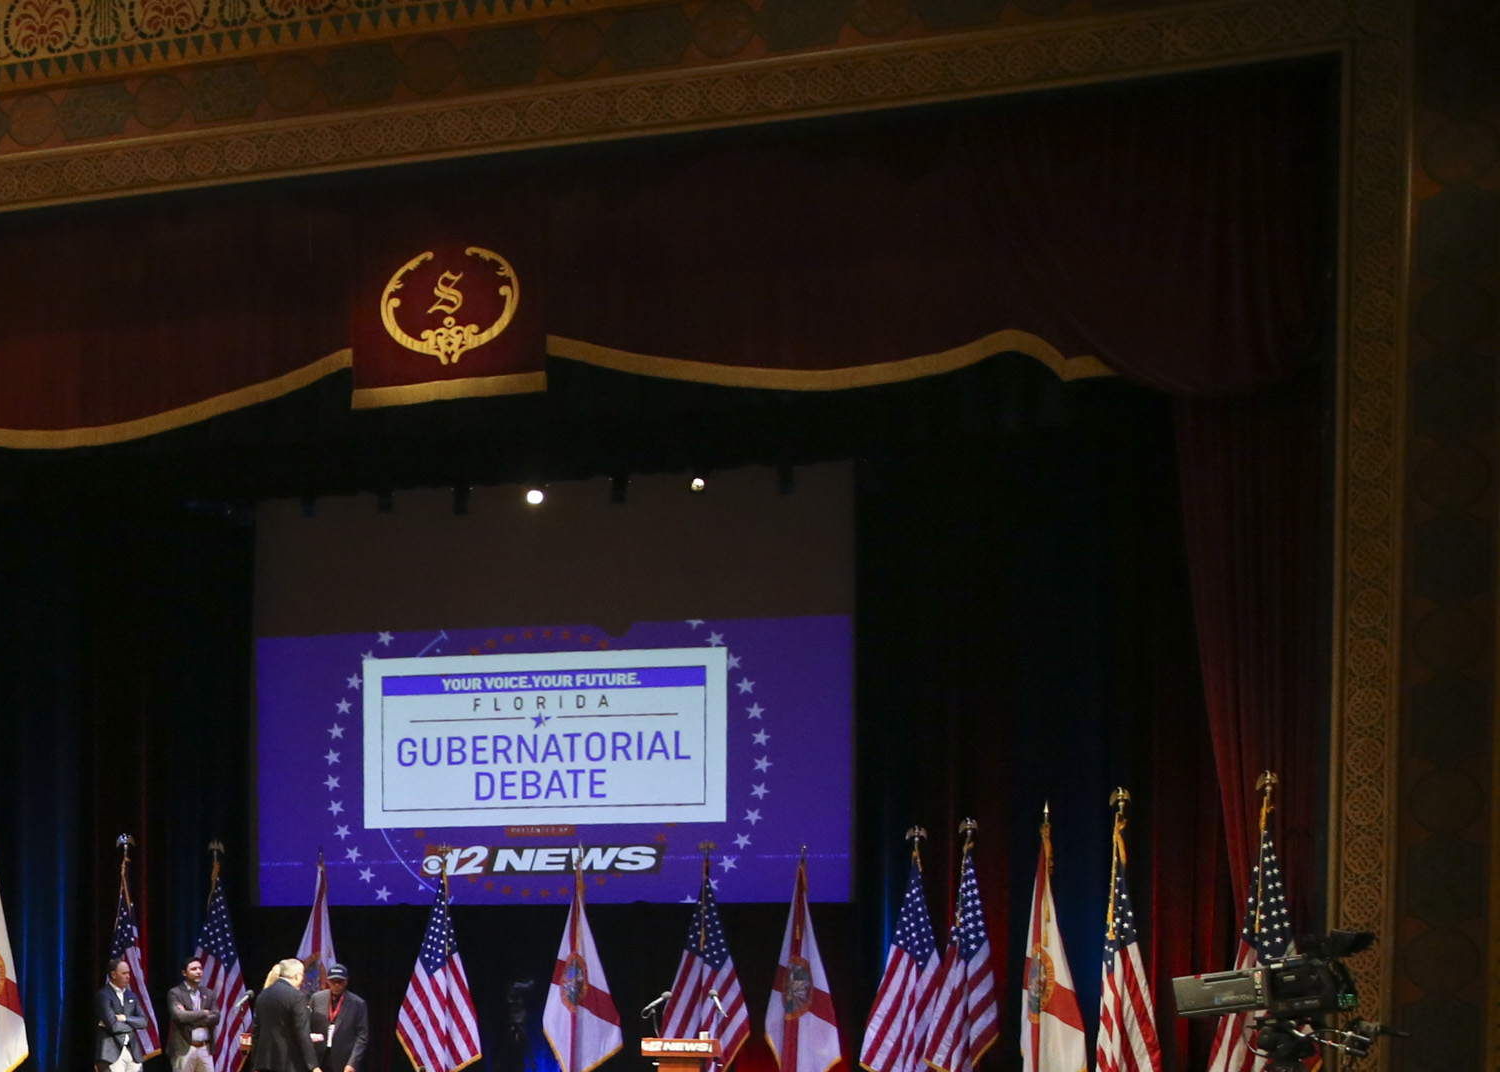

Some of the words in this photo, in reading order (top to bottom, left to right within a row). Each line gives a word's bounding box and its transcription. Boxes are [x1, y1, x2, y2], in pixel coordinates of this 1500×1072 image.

[441, 678, 482, 692] YOUR
[575, 672, 642, 687] FUTURE.
[472, 694, 609, 712] FLORIDA
[396, 730, 692, 767] GUBERNATORIAL
[474, 769, 607, 801] DEBATE
[492, 846, 657, 872] NEWS
[663, 1042, 709, 1052] NEWS
